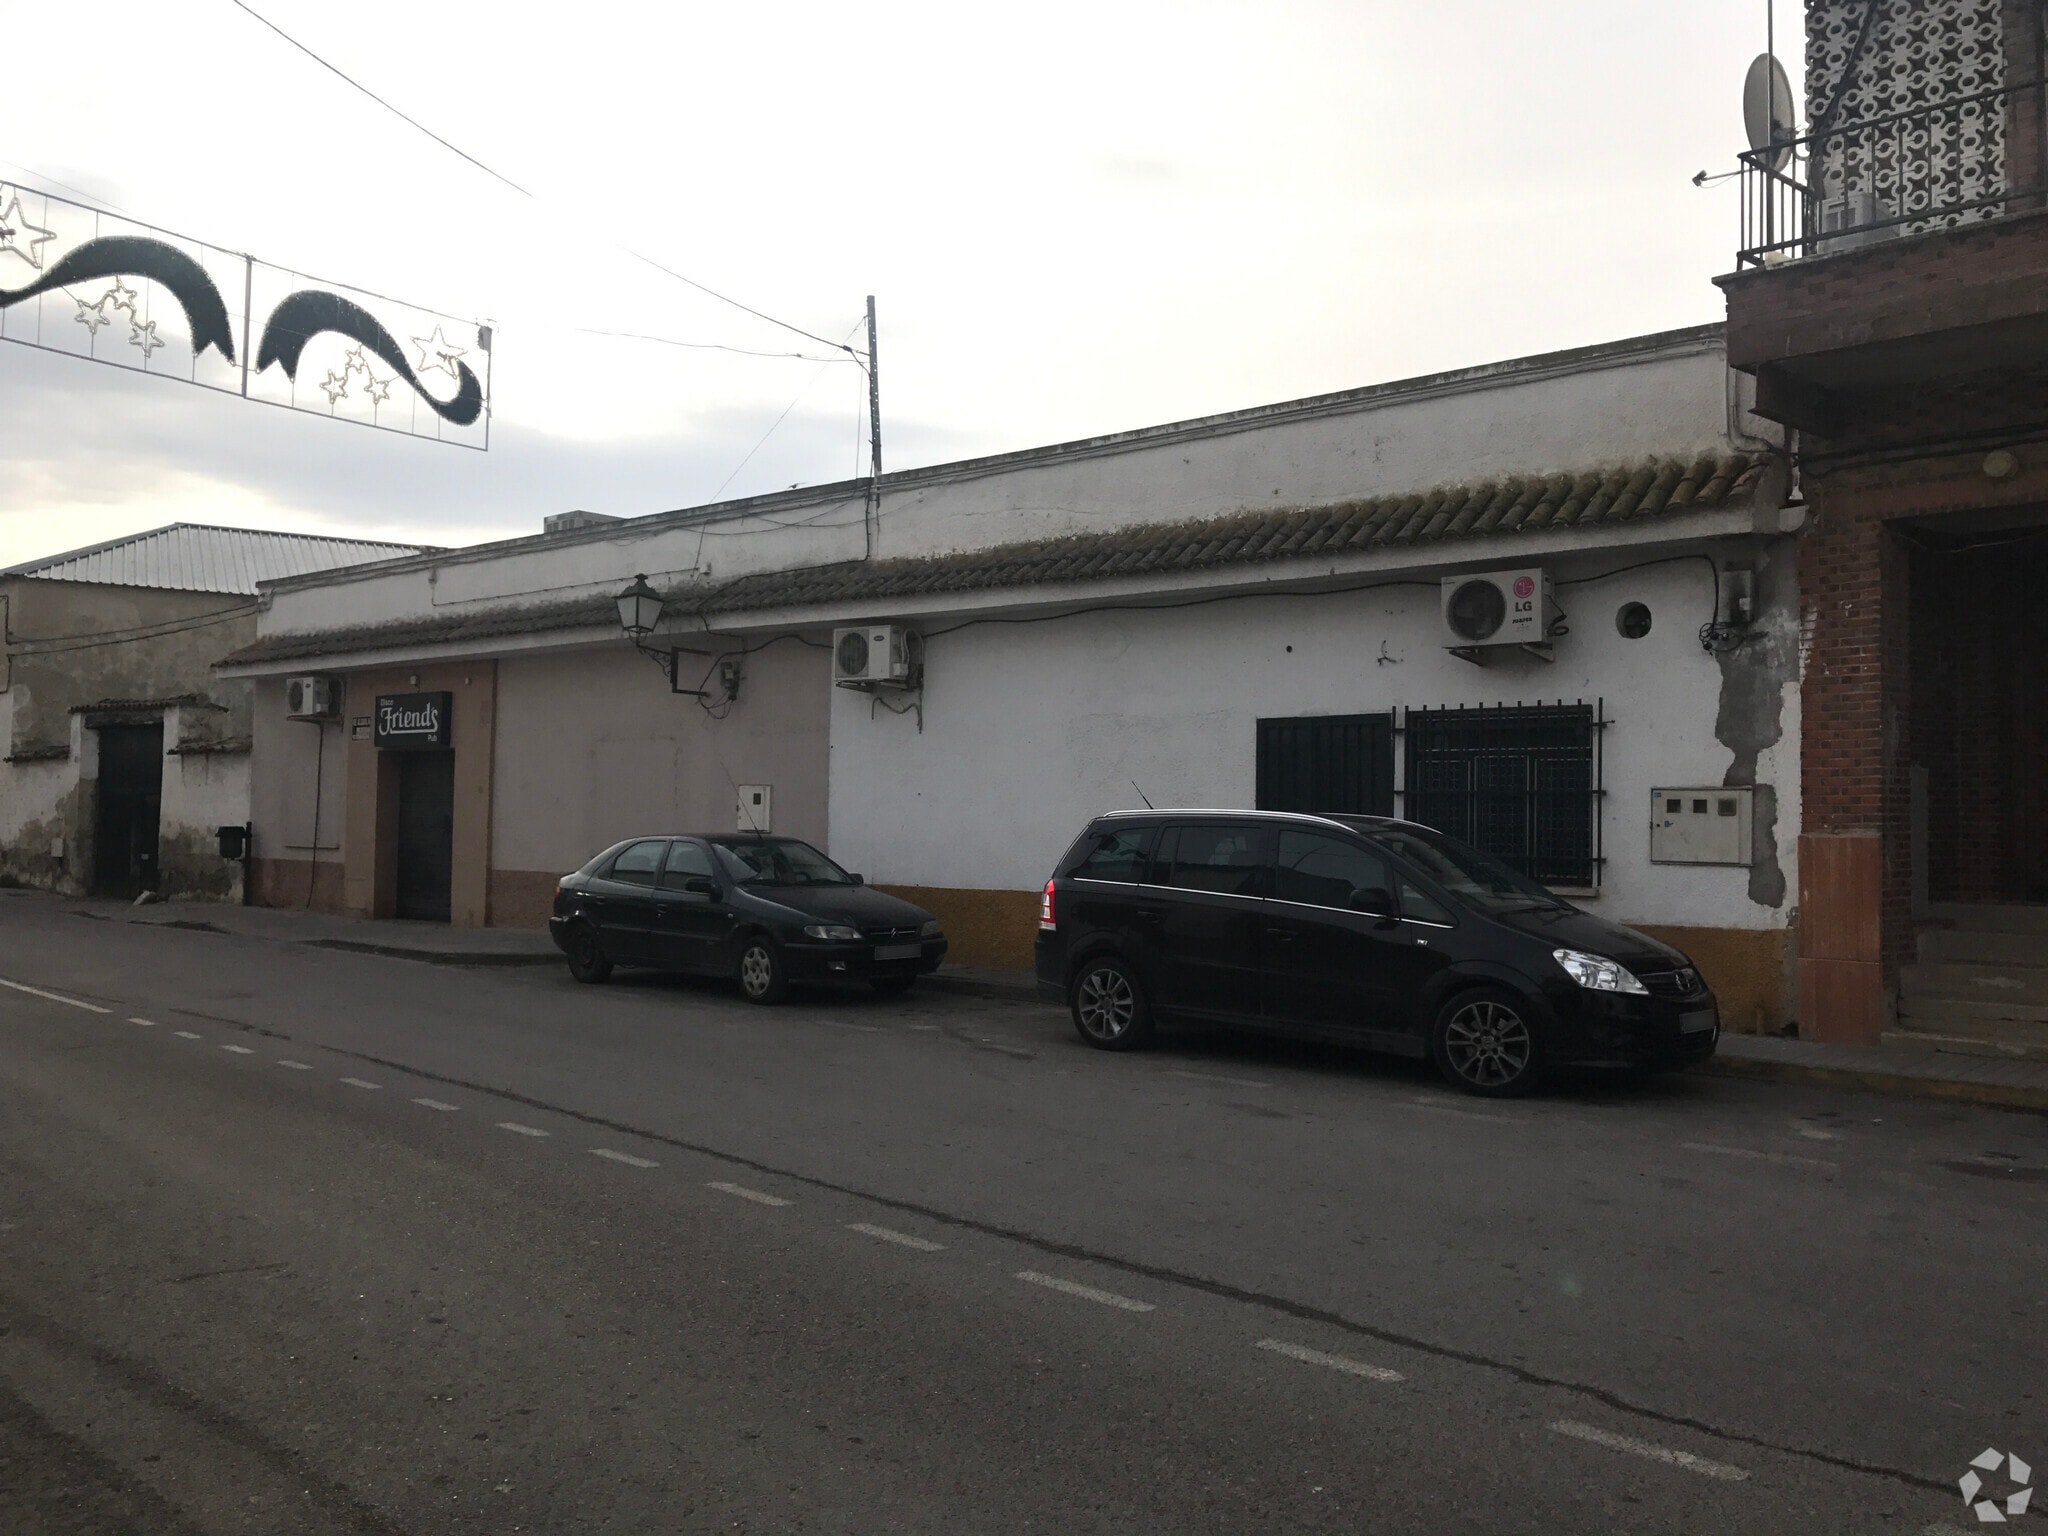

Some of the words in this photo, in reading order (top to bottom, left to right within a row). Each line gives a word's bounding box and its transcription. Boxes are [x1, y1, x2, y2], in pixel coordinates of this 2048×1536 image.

[1515, 601, 1532, 612] LG
[380, 698, 394, 706] Disco
[427, 734, 437, 742] Pub
